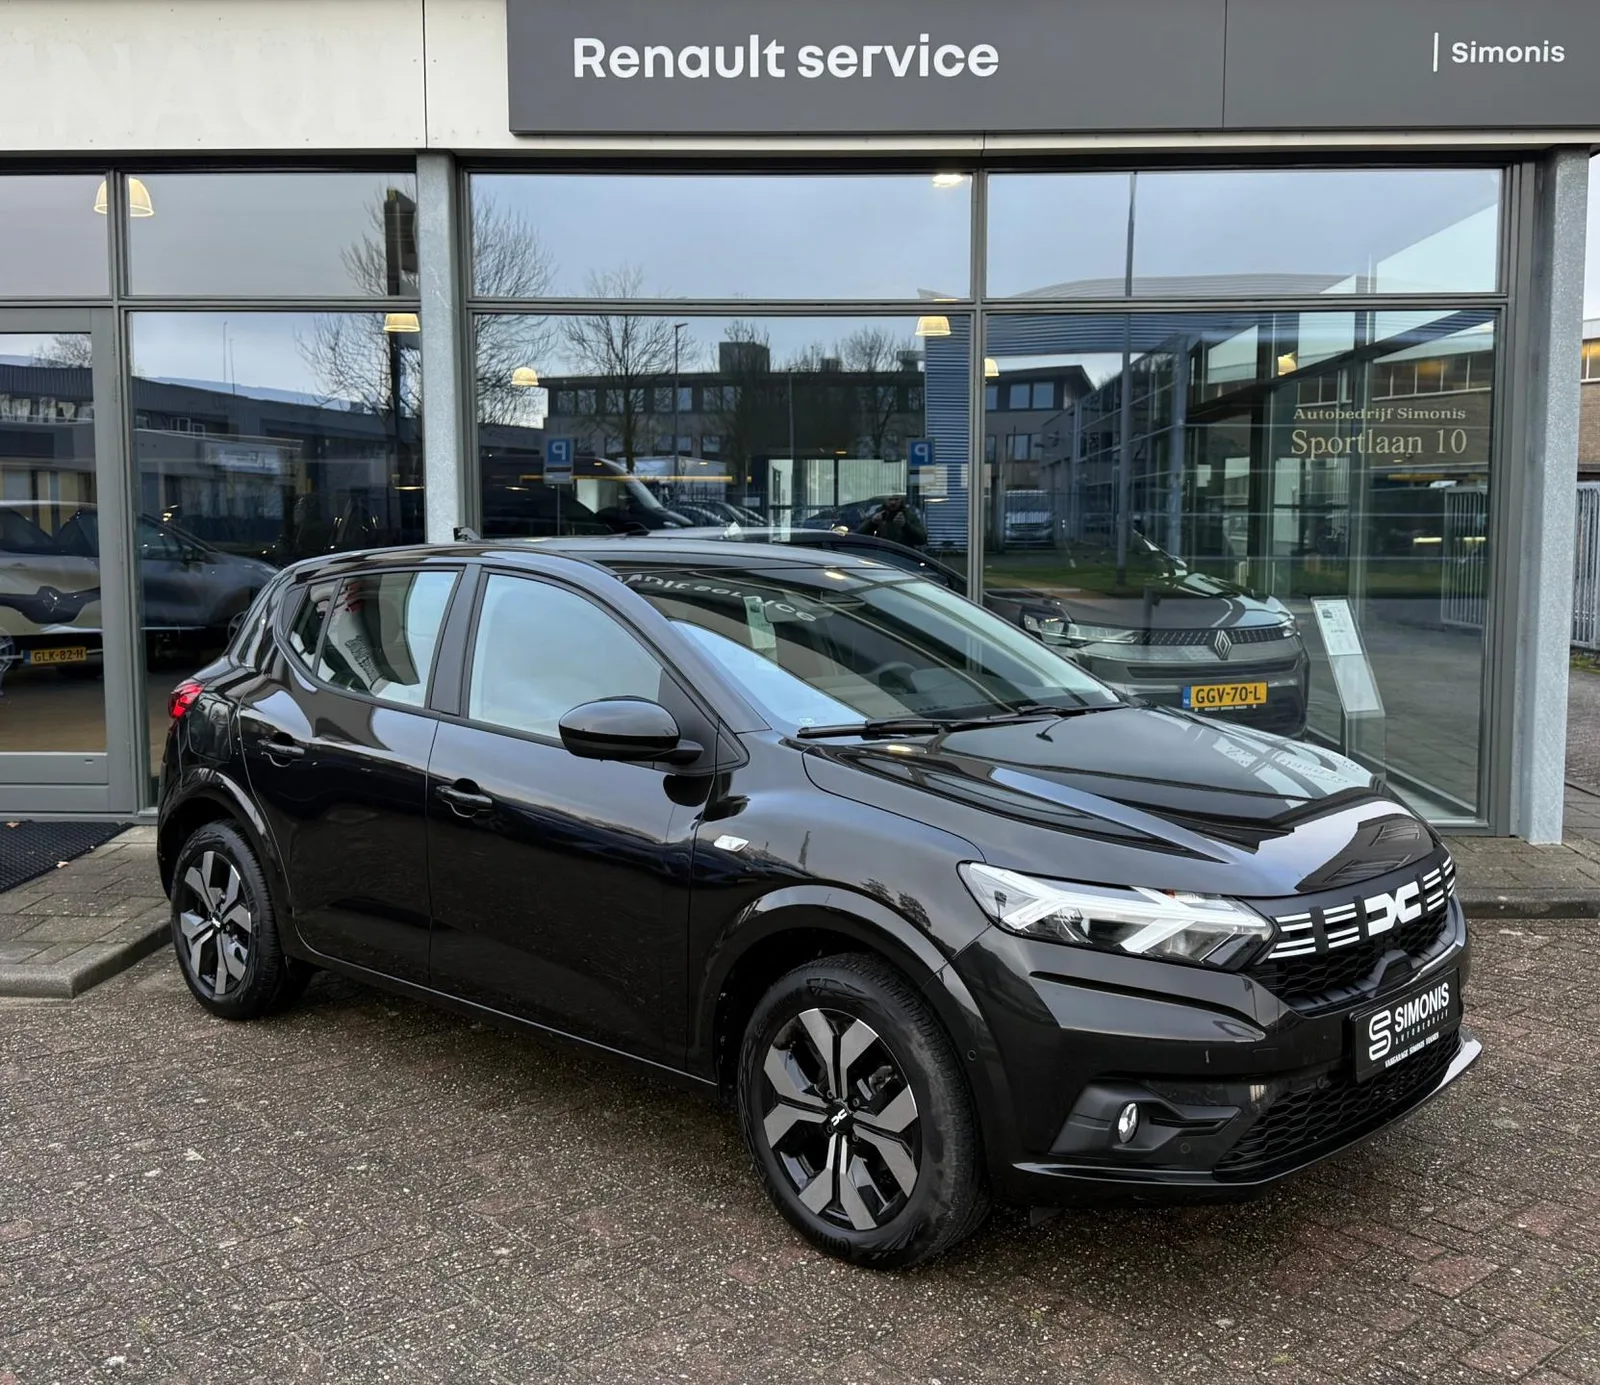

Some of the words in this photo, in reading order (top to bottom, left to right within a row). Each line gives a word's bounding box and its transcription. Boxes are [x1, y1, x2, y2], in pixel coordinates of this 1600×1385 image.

[573, 34, 786, 79] Renault
[797, 33, 999, 78] service
[1451, 40, 1566, 63] Simonis
[1293, 408, 1394, 422] Autobedrijf
[1397, 408, 1466, 420] Simonis
[1291, 429, 1423, 461] Sportlaan
[1436, 429, 1467, 454] 10
[34, 650, 84, 662] GLK-82-H
[1195, 686, 1262, 703] GGV-70-L
[1394, 982, 1449, 1033] SIMONIS
